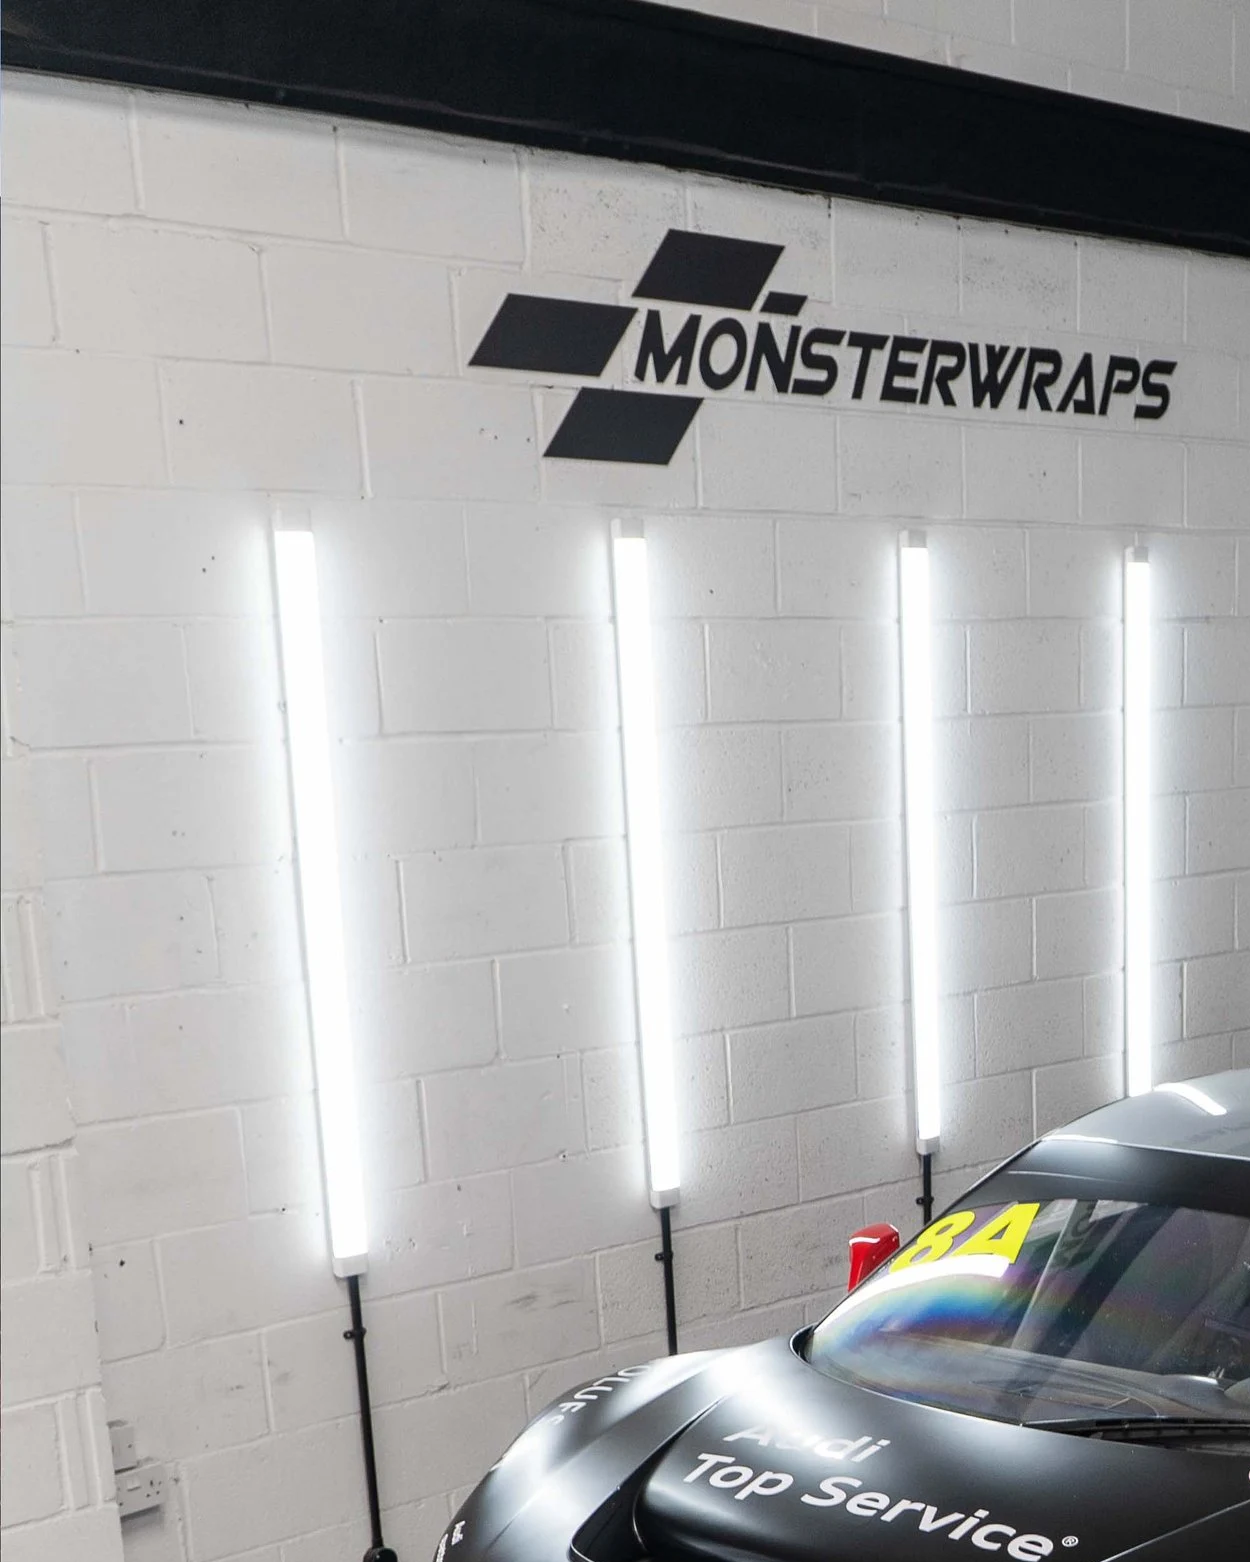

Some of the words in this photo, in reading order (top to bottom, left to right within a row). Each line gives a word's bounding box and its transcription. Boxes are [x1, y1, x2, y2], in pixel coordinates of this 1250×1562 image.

[634, 308, 1178, 420] MONSTERWRAPS
[888, 1202, 1041, 1274] 8A
[682, 1453, 794, 1501] Top
